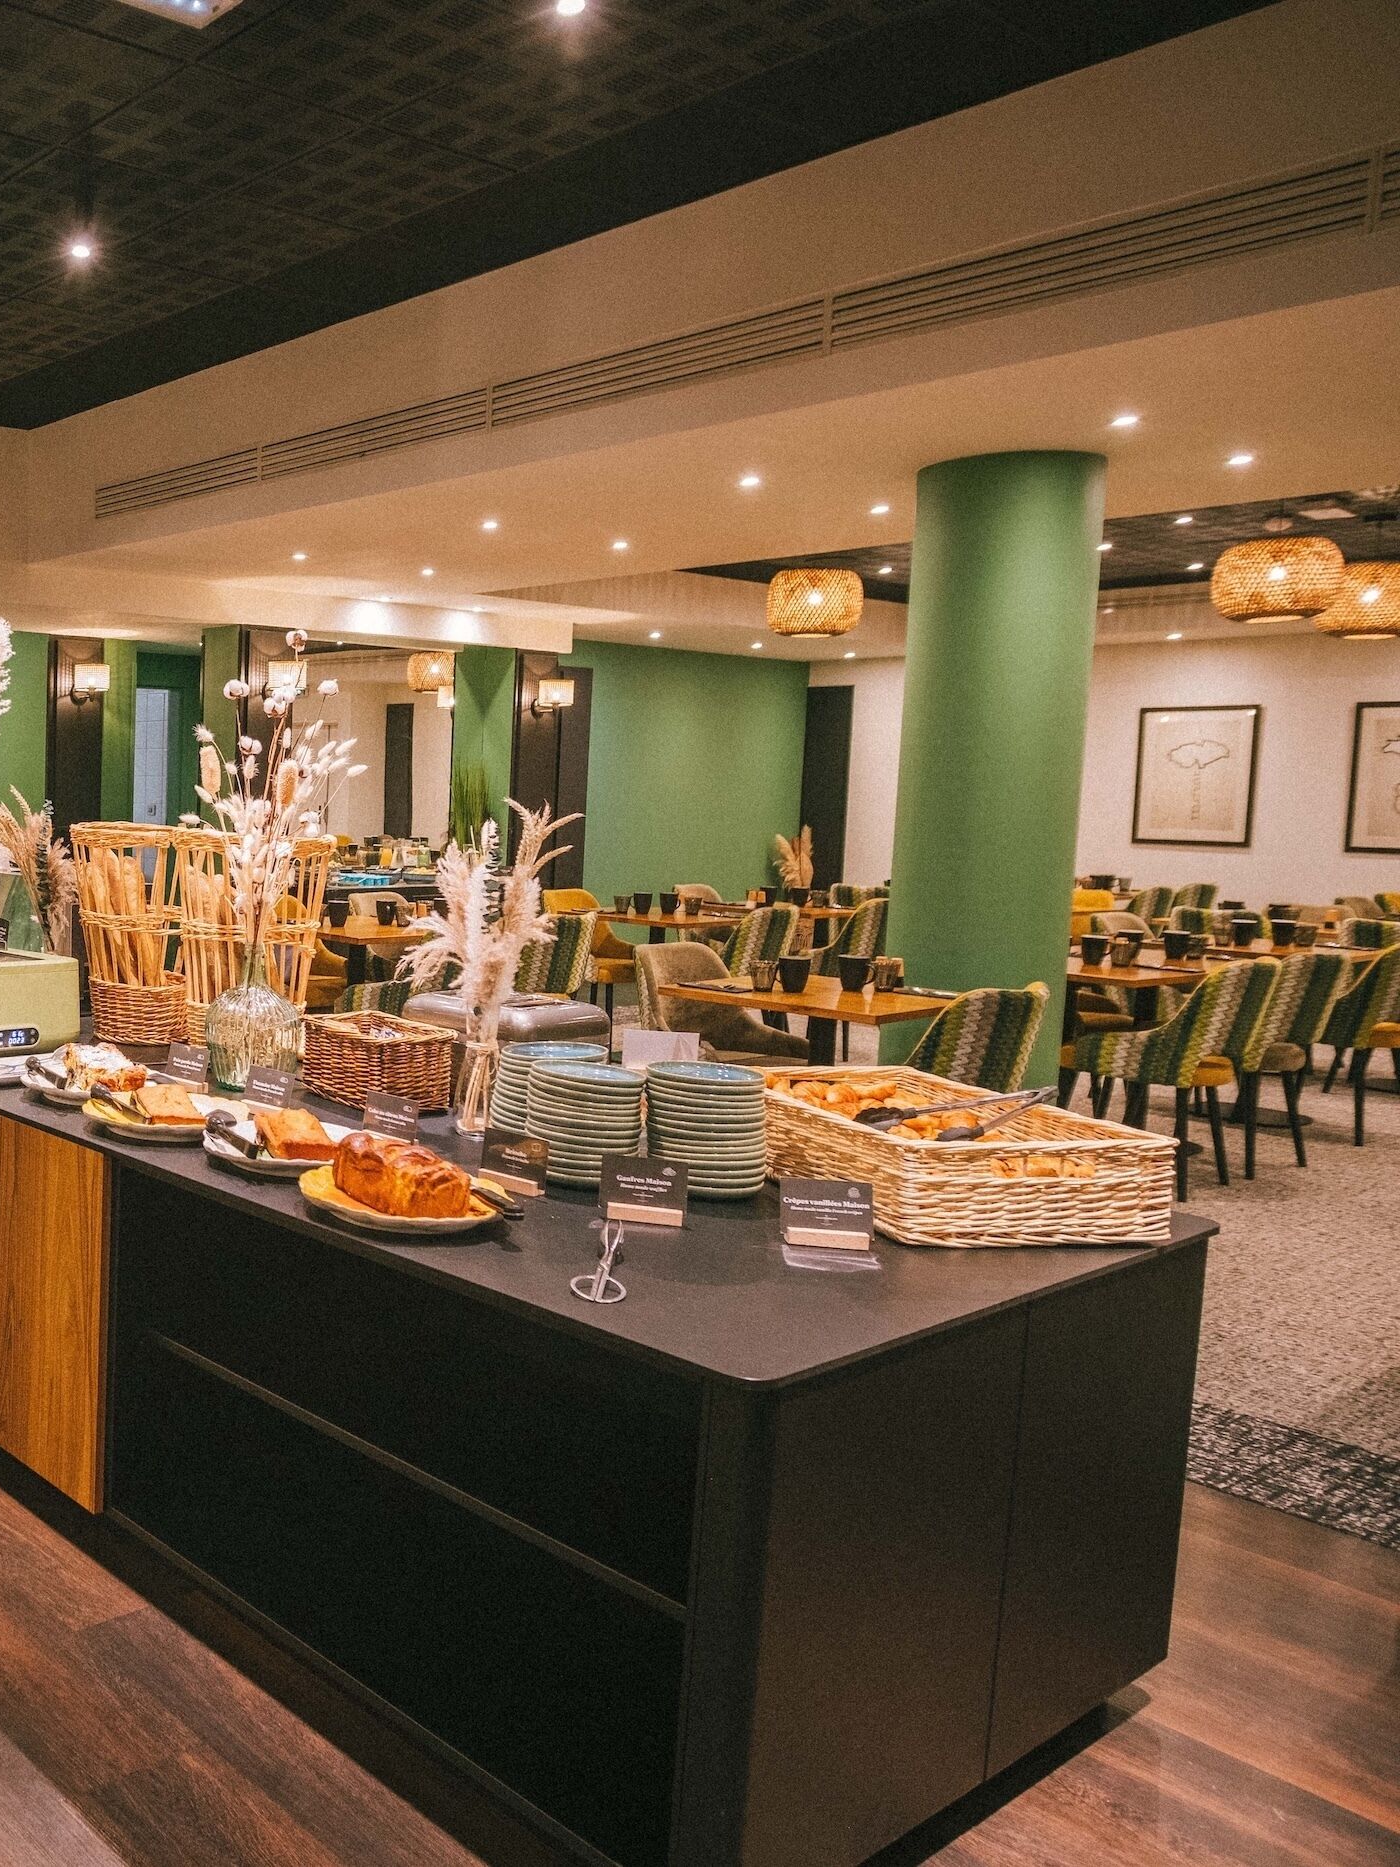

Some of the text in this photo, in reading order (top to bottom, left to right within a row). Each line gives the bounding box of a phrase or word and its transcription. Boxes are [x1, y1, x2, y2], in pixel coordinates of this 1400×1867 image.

[616, 1174, 673, 1187] Gaufres Maison
[783, 1196, 871, 1210] Crêpes vanillées Maison
